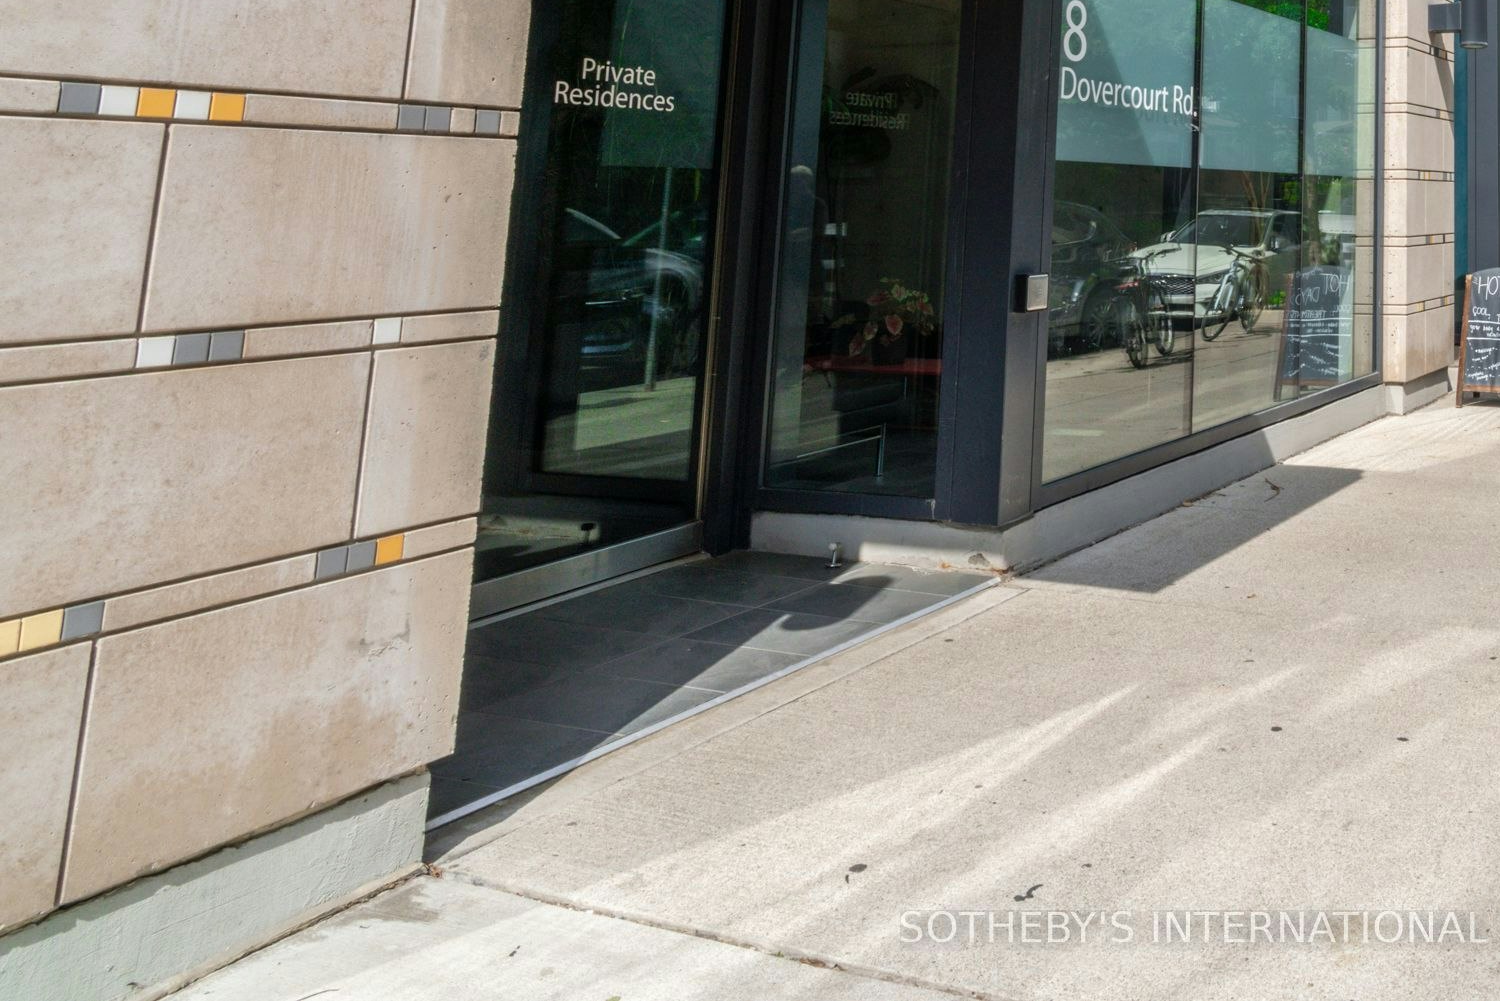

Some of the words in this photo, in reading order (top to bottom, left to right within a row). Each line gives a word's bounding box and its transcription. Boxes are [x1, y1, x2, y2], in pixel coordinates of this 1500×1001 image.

[1063, 0, 1087, 62] 8
[582, 57, 656, 86] Private
[1060, 66, 1168, 112] Dovercourt
[1173, 85, 1198, 117] Rd.
[554, 80, 675, 112] Residences
